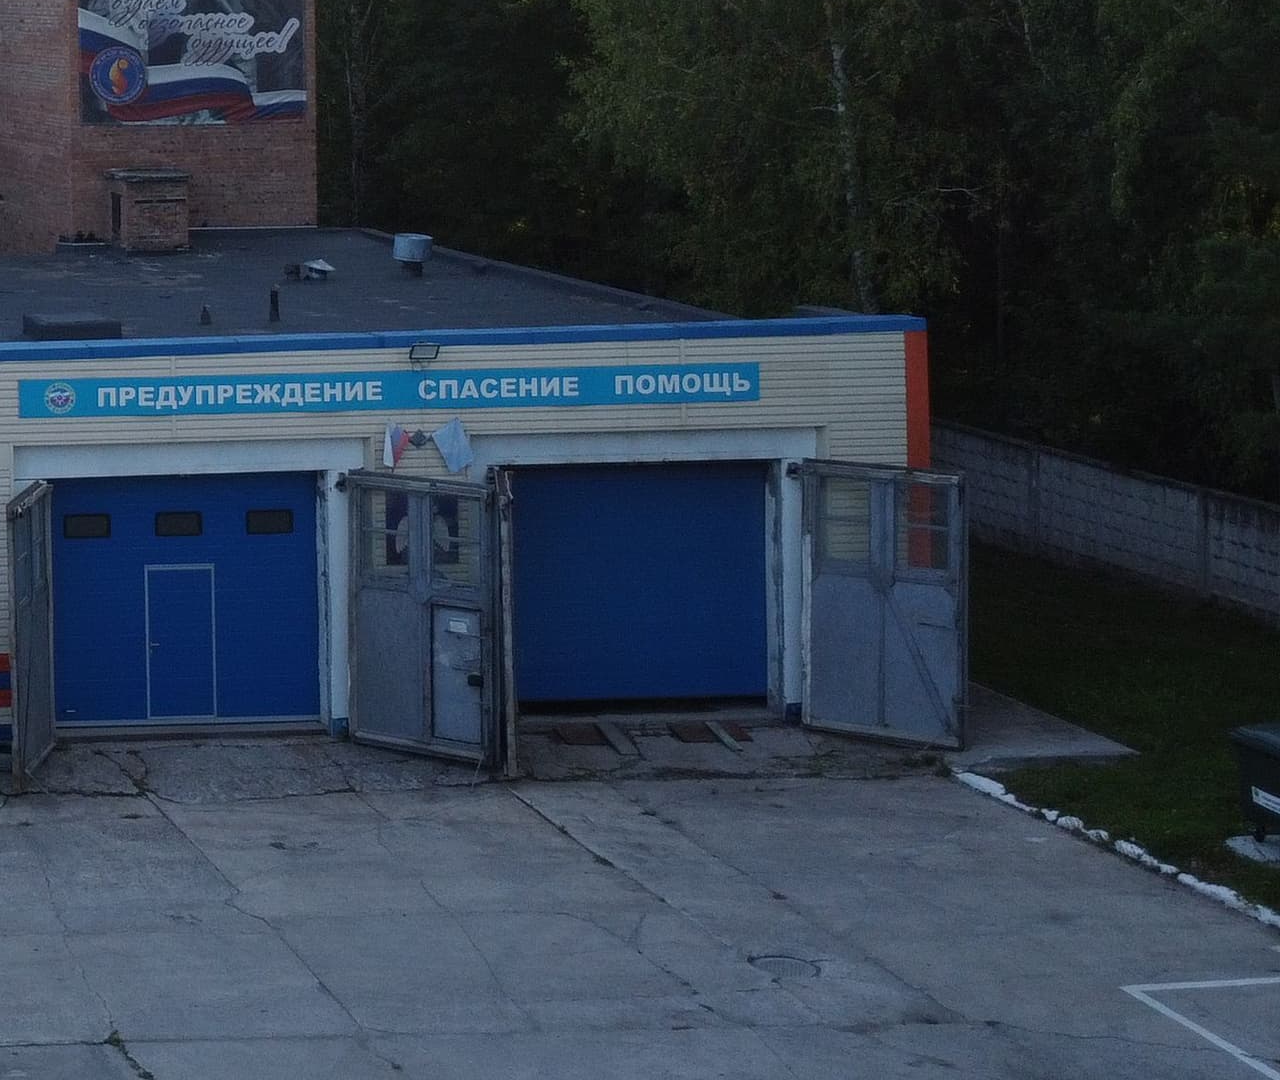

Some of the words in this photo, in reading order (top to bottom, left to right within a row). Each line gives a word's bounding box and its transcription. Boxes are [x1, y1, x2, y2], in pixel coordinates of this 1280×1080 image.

[97, 380, 384, 410] ПРЕДУПРЕЖДЕНИЕ
[417, 376, 580, 401] СПАСЕНИЕ
[614, 372, 752, 397] ПОМОЩЬ
